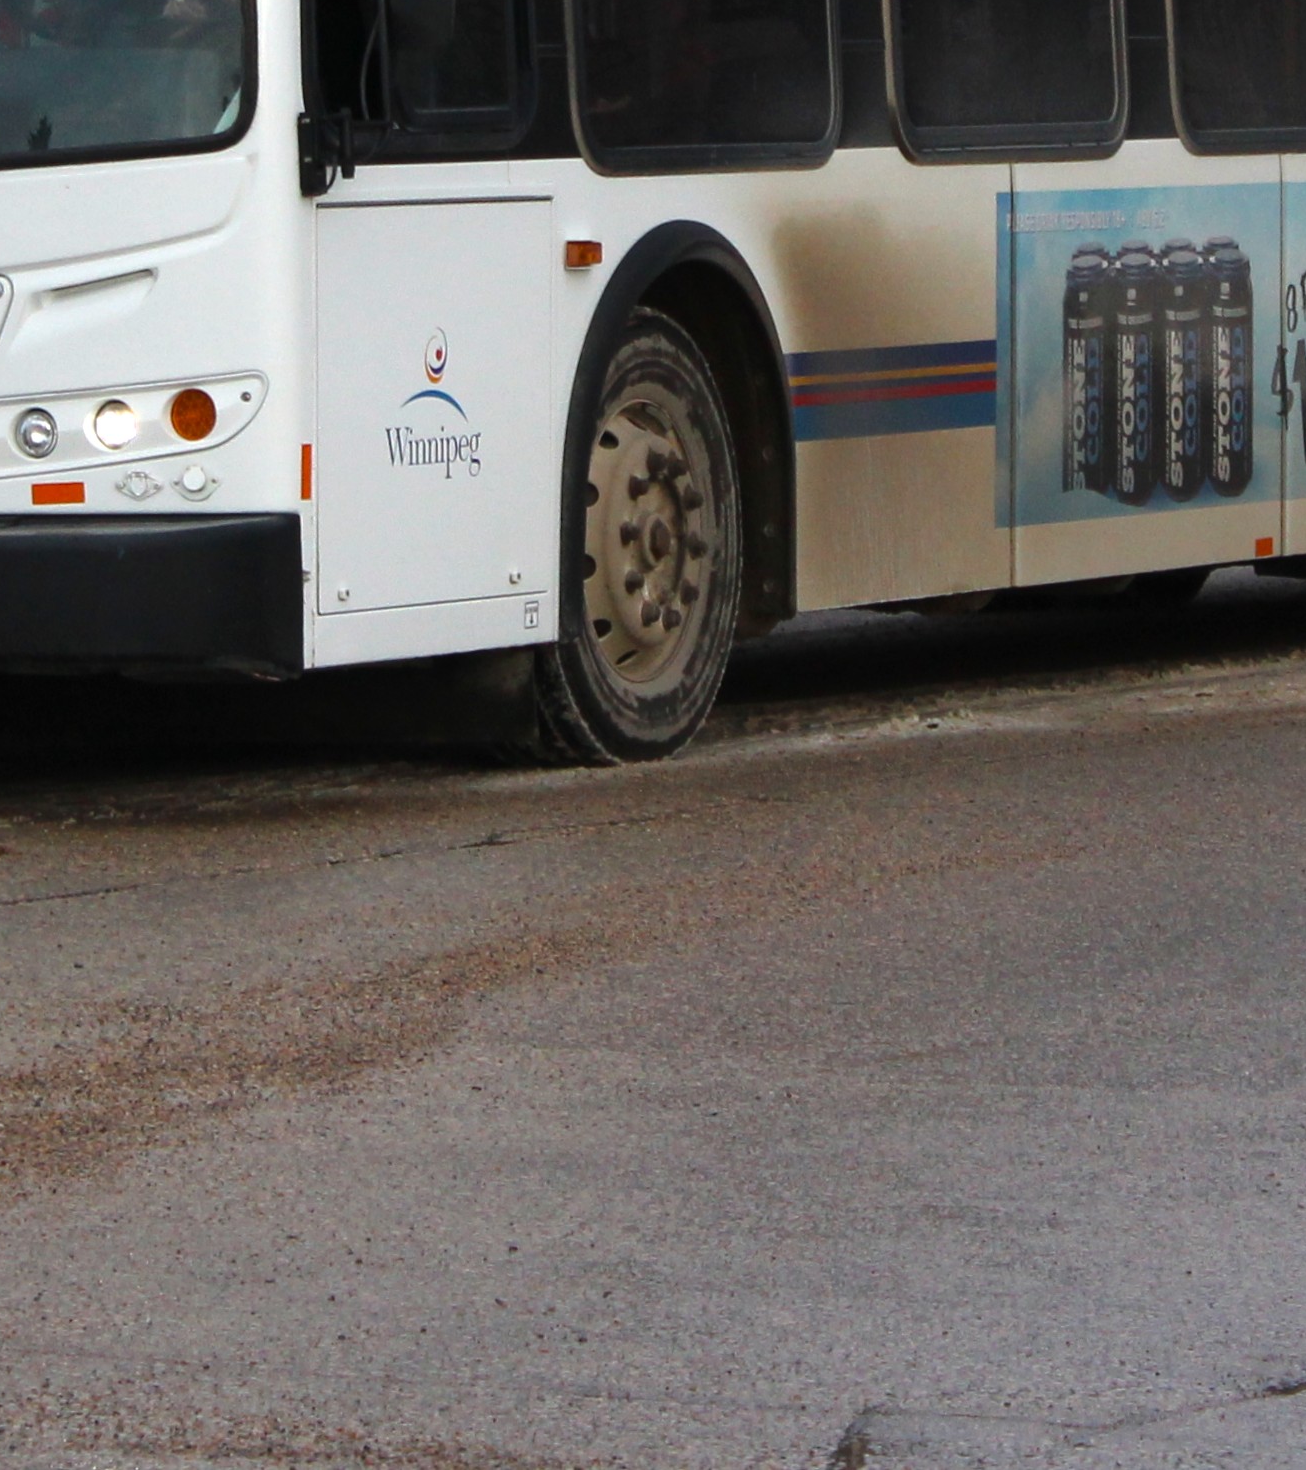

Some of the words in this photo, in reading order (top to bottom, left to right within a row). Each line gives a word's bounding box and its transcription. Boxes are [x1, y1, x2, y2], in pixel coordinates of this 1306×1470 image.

[1286, 283, 1299, 333] 8
[384, 425, 481, 479] Winnipeg
[1121, 334, 1135, 493] STONE
[1171, 330, 1183, 487] STONE
[1218, 325, 1230, 482] STONE
